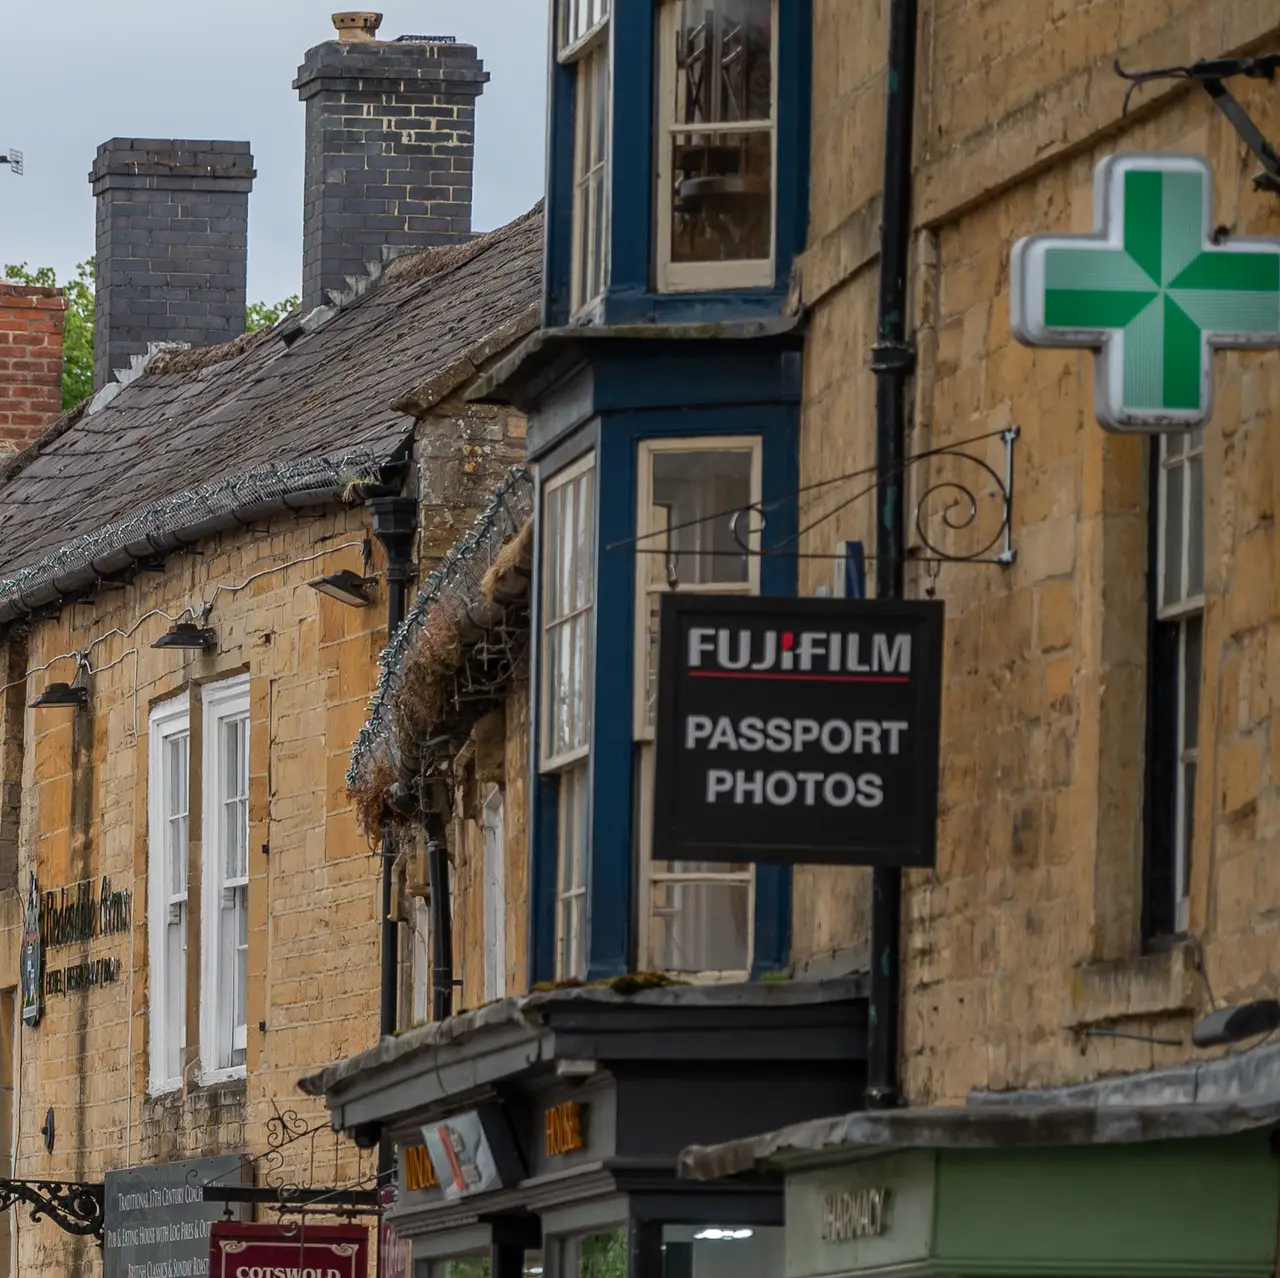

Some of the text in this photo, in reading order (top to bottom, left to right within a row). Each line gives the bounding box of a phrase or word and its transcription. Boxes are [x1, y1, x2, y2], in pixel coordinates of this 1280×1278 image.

[687, 627, 912, 673] FUJIFILM
[685, 714, 909, 755] PASSPORT
[705, 768, 884, 808] PHOTOS
[822, 1187, 886, 1241] PHARMACY
